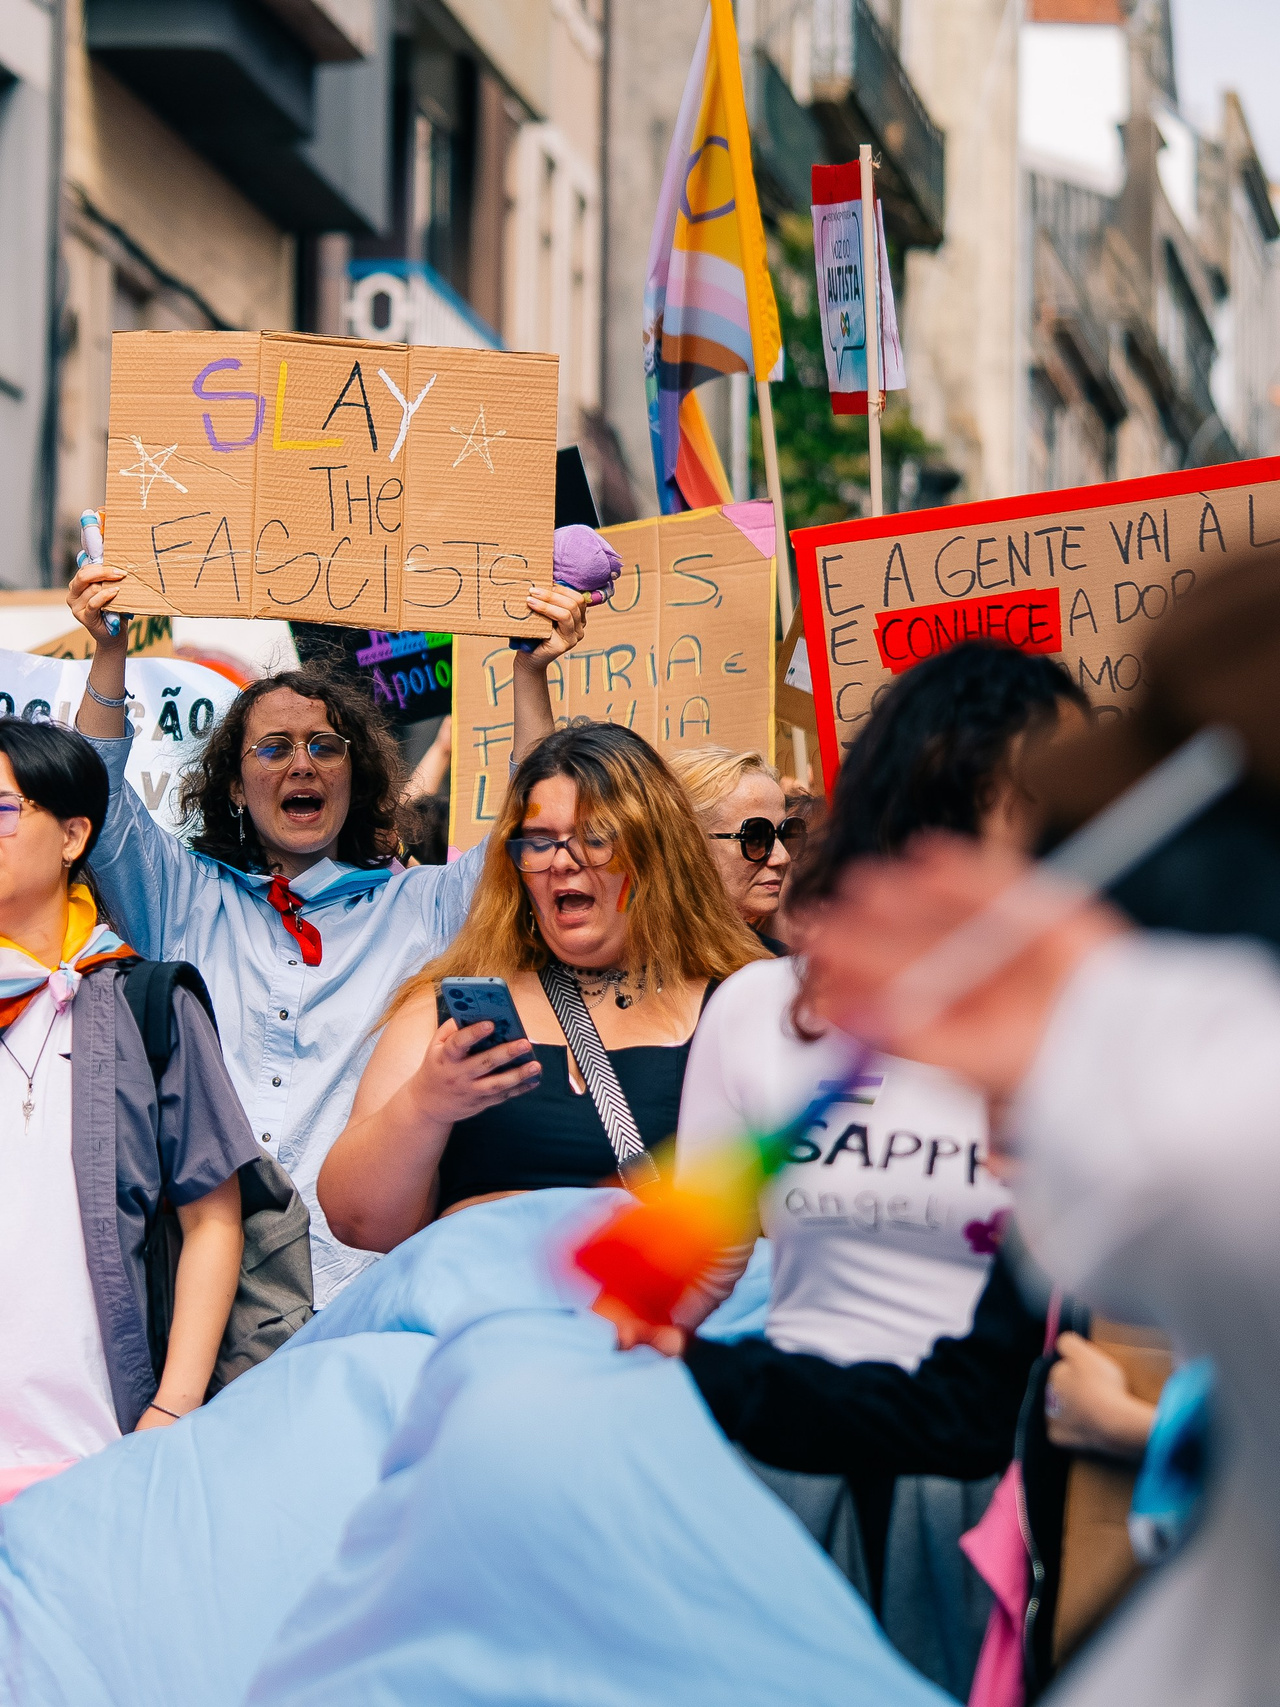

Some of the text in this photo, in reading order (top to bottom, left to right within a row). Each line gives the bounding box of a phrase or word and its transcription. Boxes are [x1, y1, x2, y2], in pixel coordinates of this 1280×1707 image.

[827, 265, 860, 302] AUTISTA
[193, 358, 437, 462] SLAY
[151, 512, 535, 620] FASCISTS
[822, 555, 865, 616] E
[883, 543, 915, 607] A
[935, 526, 1086, 598] GENTE
[1109, 509, 1170, 564] VAI
[1198, 491, 1227, 552] À
[831, 620, 869, 666] E
[1070, 588, 1098, 636] A
[373, 652, 452, 709] Apoio
